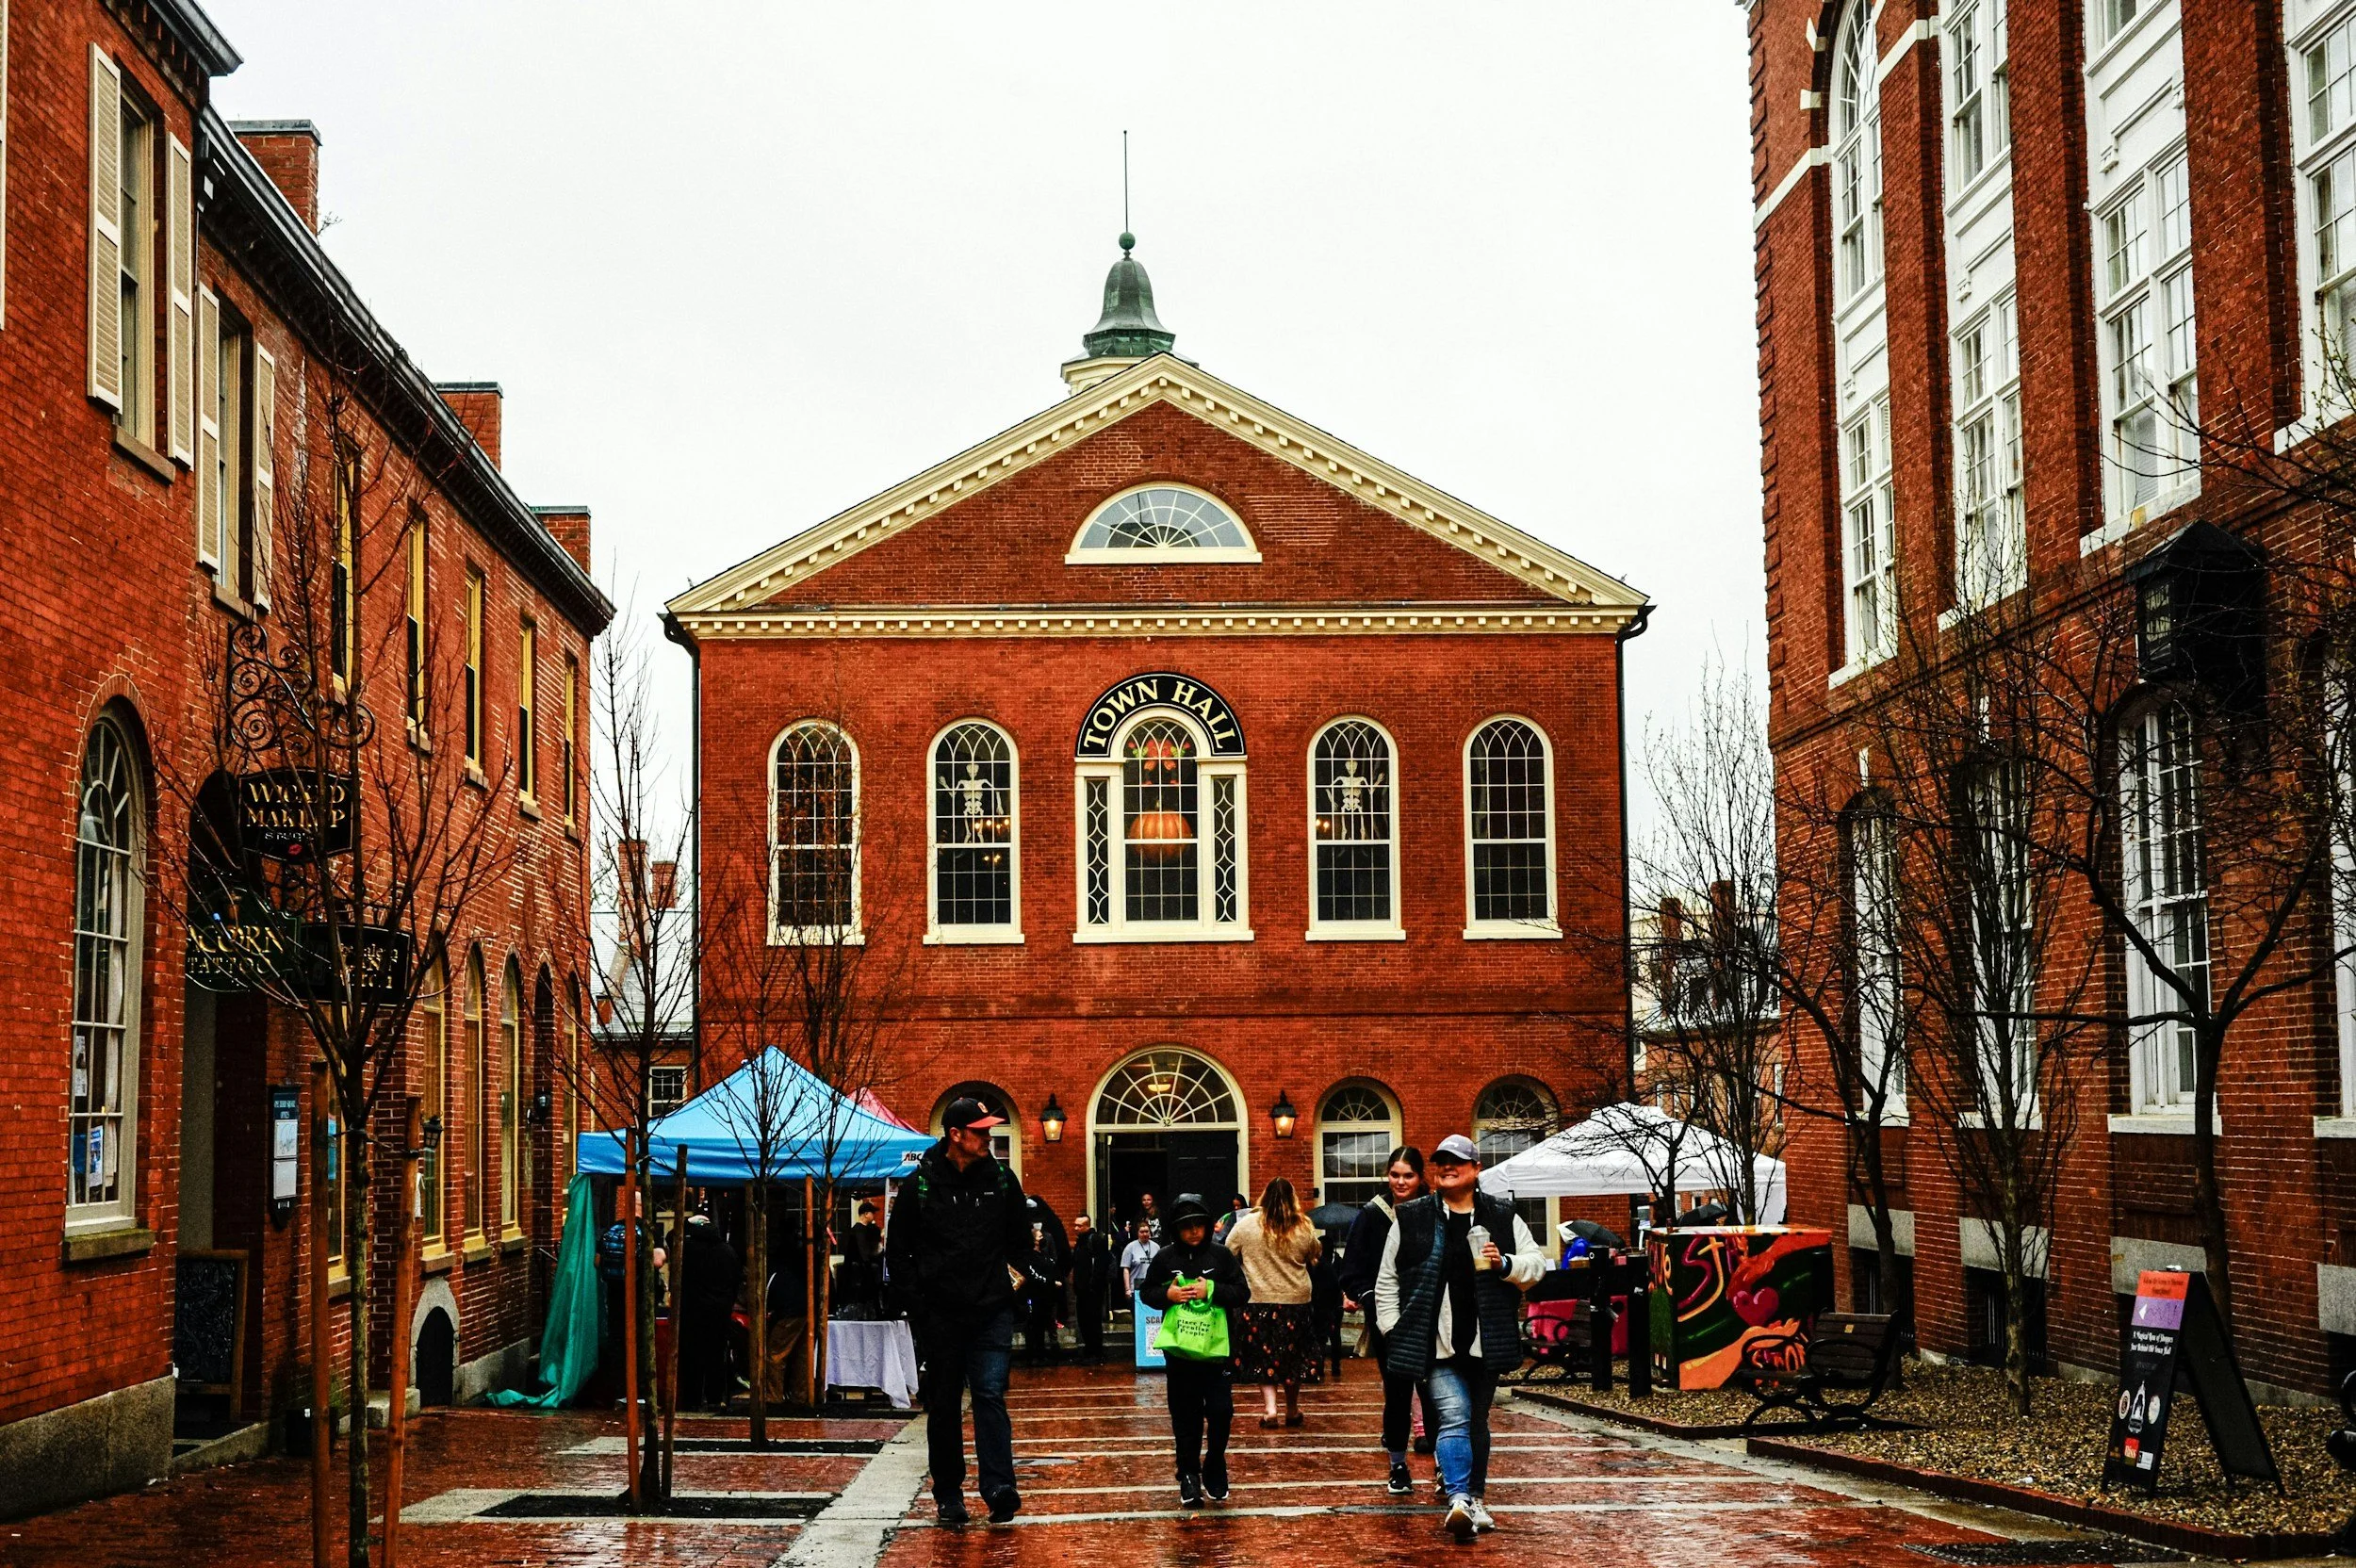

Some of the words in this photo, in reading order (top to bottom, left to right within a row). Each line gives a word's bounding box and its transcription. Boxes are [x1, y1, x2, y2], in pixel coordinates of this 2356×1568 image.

[1084, 678, 1158, 748] TOWN
[1170, 680, 1236, 749] HALL
[248, 782, 346, 804] WICKD
[246, 808, 346, 828] MAKEP
[1145, 1316, 1163, 1325] SCA
